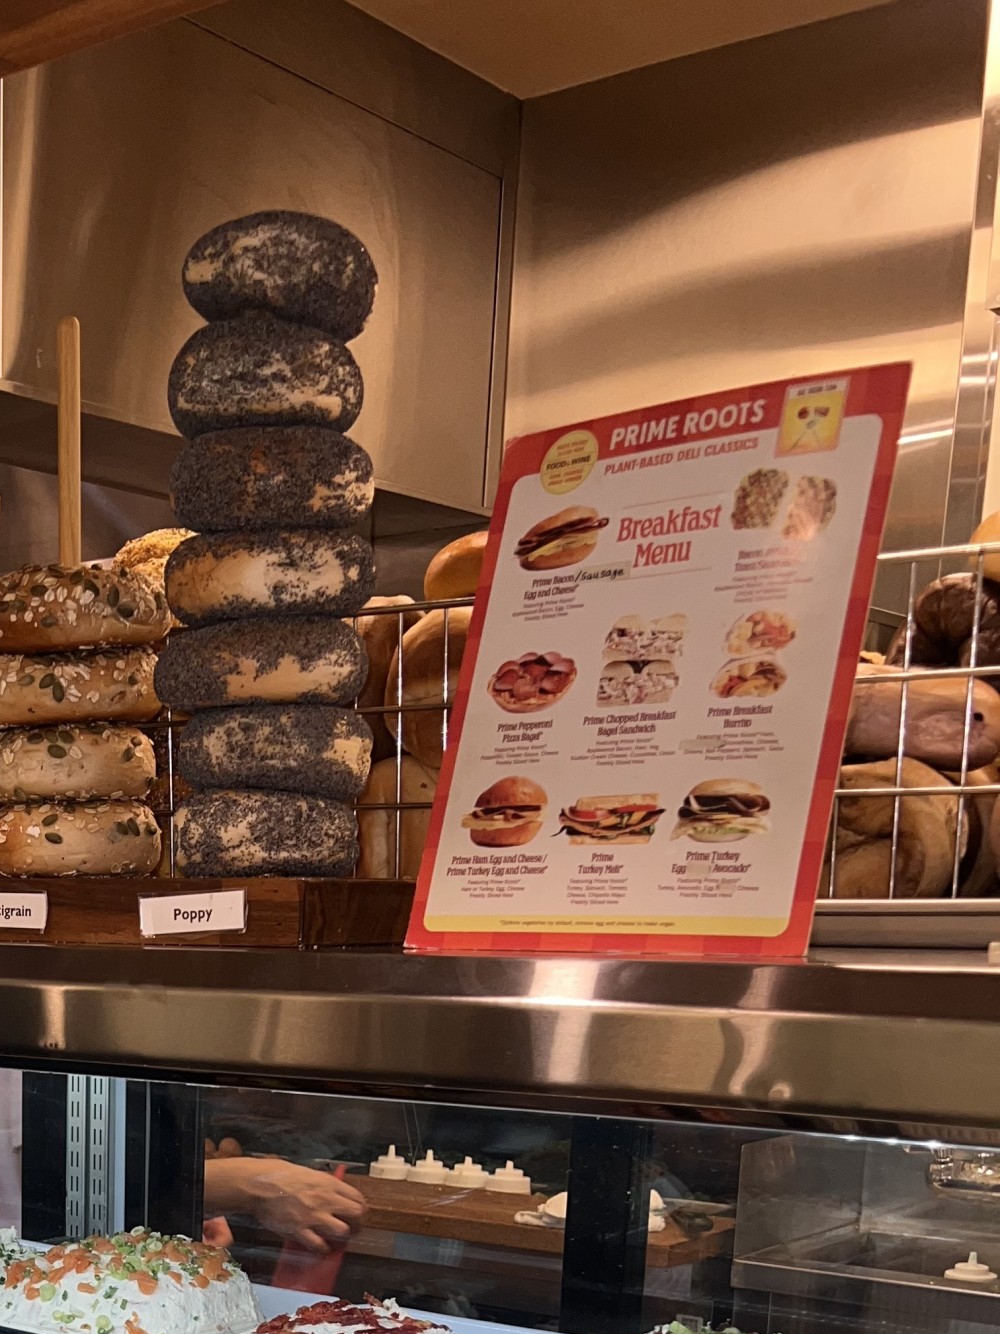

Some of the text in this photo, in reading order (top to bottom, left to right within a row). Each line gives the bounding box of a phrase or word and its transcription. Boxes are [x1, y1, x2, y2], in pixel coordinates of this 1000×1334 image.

[609, 414, 679, 451] PRIME
[683, 398, 767, 435] ROOTS
[604, 436, 759, 477] PLANT-BASED DELI CLASSICS
[616, 504, 723, 543] Breakfast
[633, 540, 692, 568] Menu
[591, 852, 614, 862] Prime
[173, 907, 212, 923] Poppy
